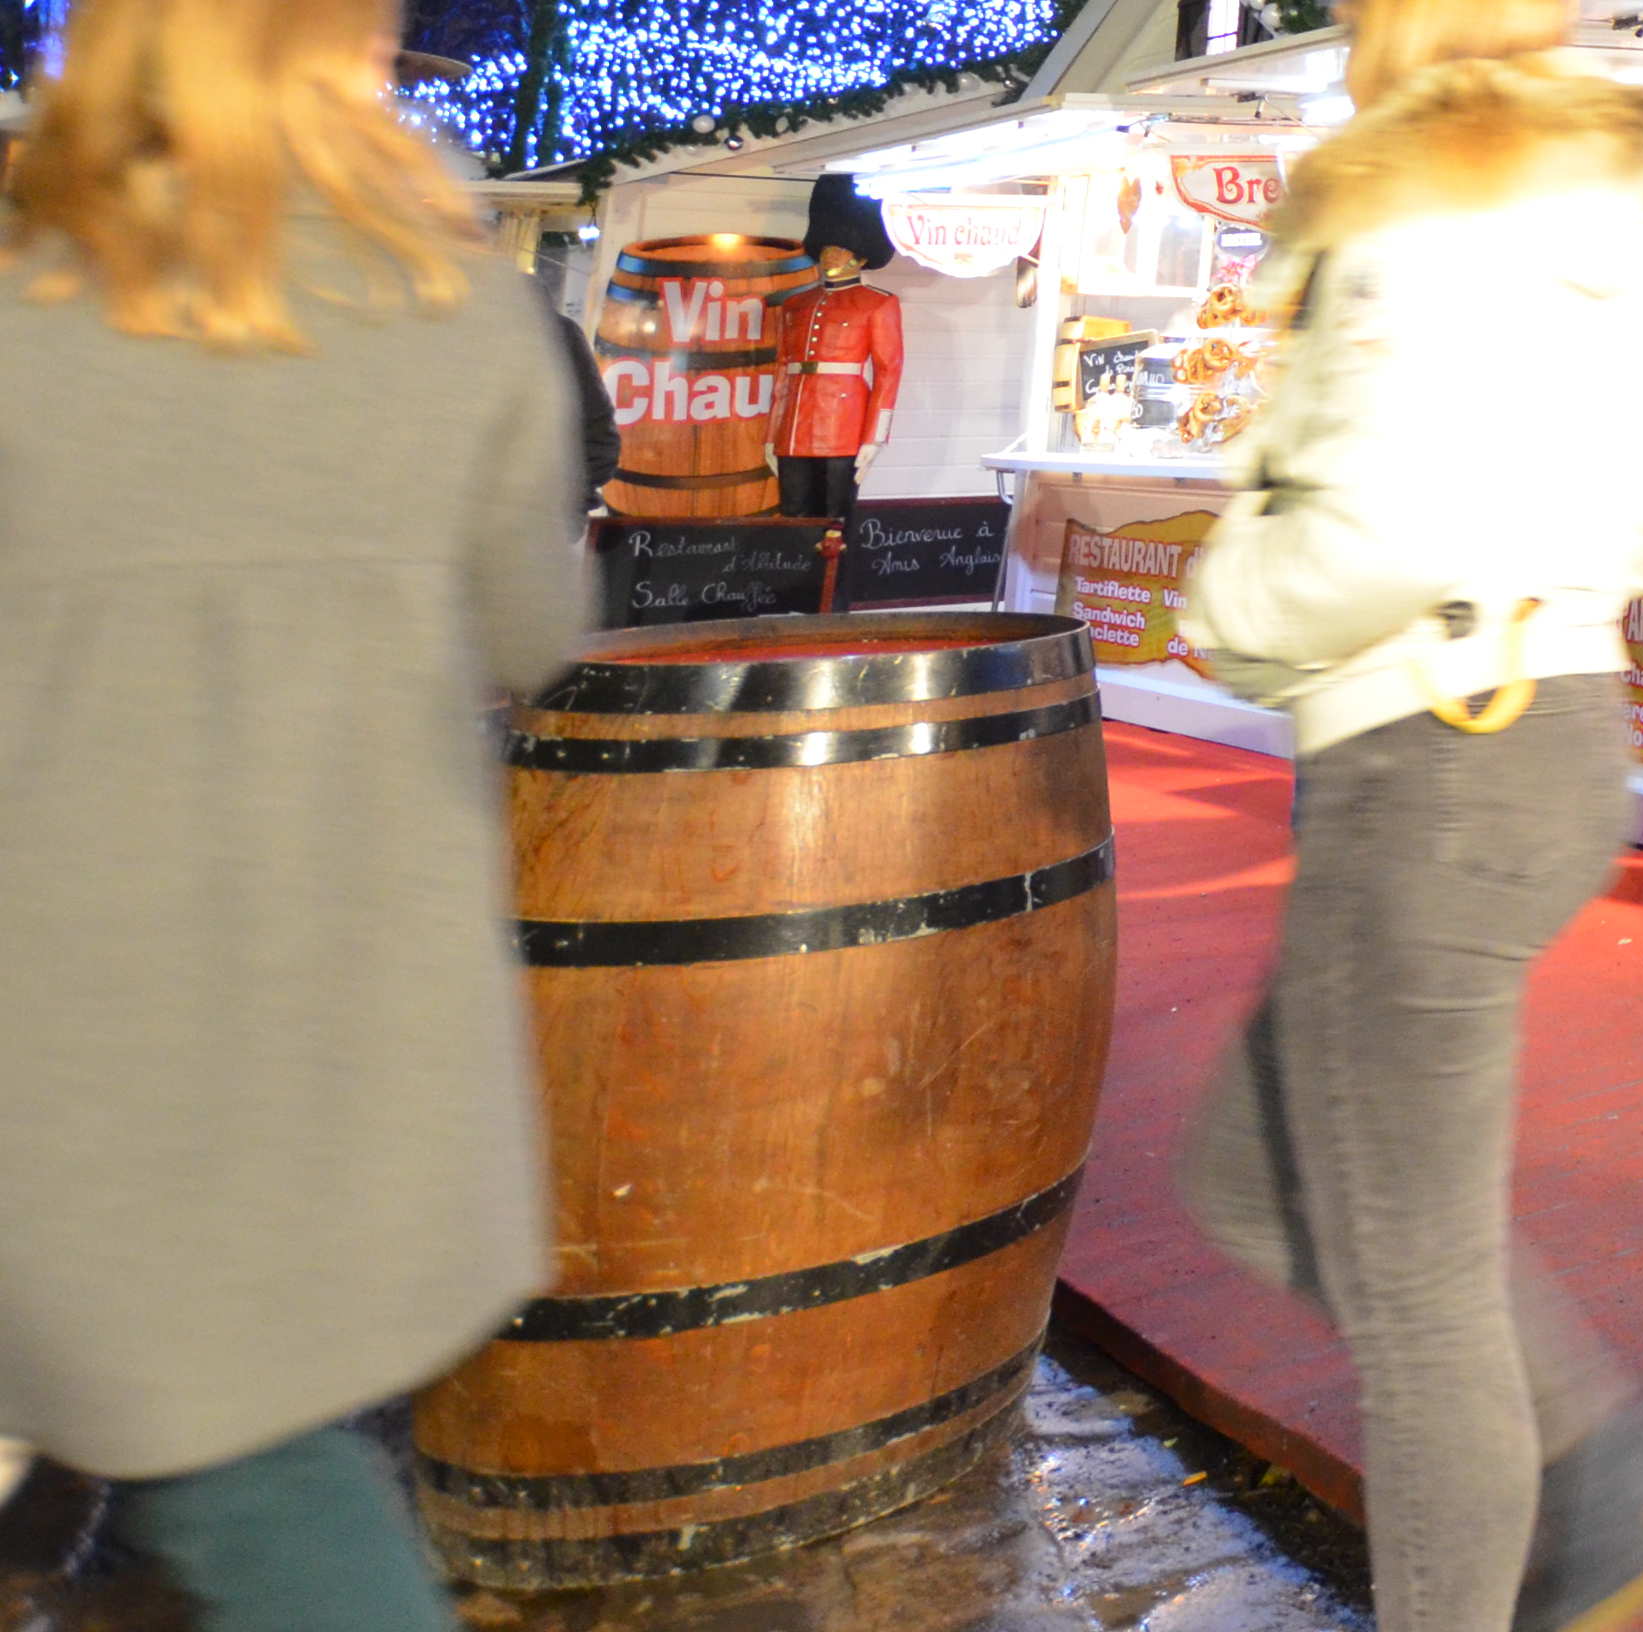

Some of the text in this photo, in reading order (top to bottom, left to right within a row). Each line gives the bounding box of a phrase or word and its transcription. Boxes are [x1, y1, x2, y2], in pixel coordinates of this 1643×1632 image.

[1212, 166, 1281, 204] Bre
[906, 214, 1023, 246] Vin chaud
[663, 280, 764, 343] Vin
[602, 359, 774, 426] Chau
[860, 519, 994, 549] Bienvenue à
[872, 545, 1001, 576] Amis Anglais
[1069, 534, 1182, 579] RESTAURANT
[632, 581, 777, 611] Salle Chauffée
[1075, 577, 1188, 610] Tartiflette Vin
[1073, 602, 1146, 630] Sandwich
[1090, 625, 1140, 647] aclette
[1167, 637, 1188, 657] de
